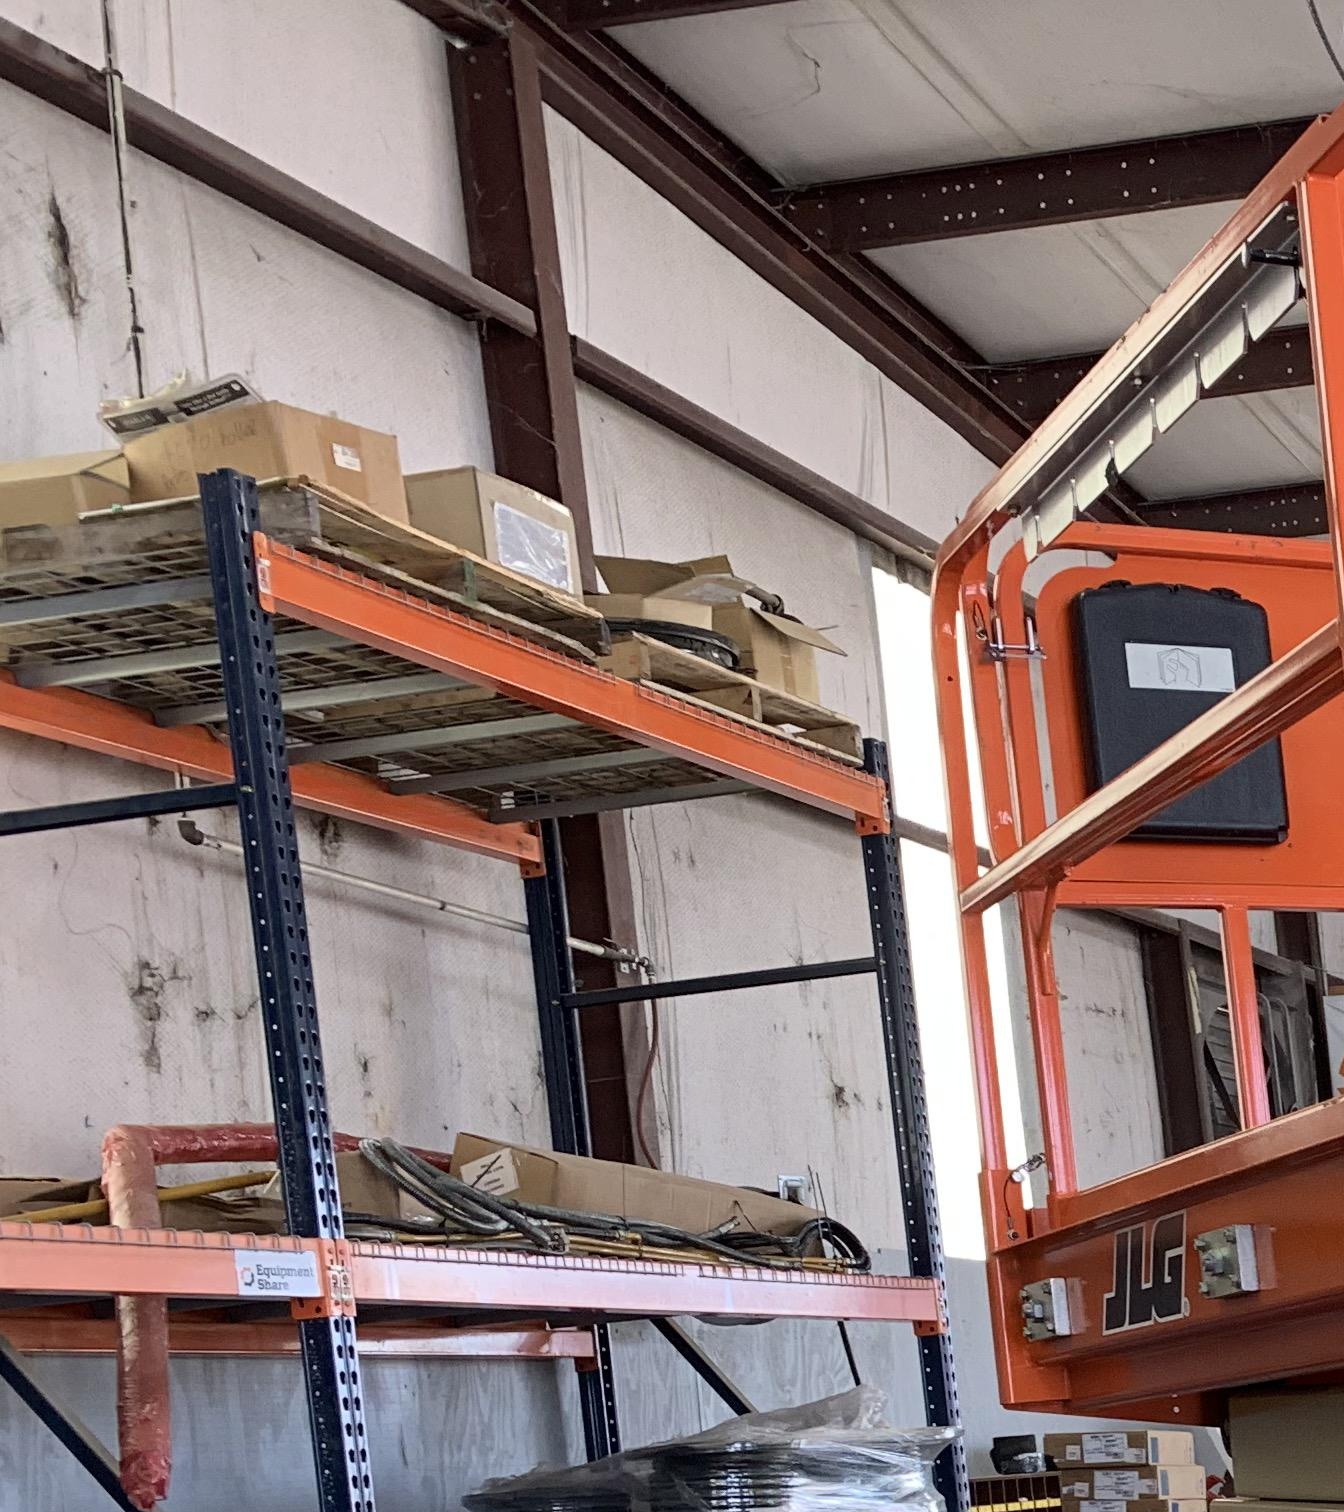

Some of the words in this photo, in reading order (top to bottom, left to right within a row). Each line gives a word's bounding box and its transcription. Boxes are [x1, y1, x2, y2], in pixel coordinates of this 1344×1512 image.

[256, 1264, 314, 1280] Equipment
[1103, 1209, 1187, 1335] JLG
[258, 1279, 289, 1290] Share
